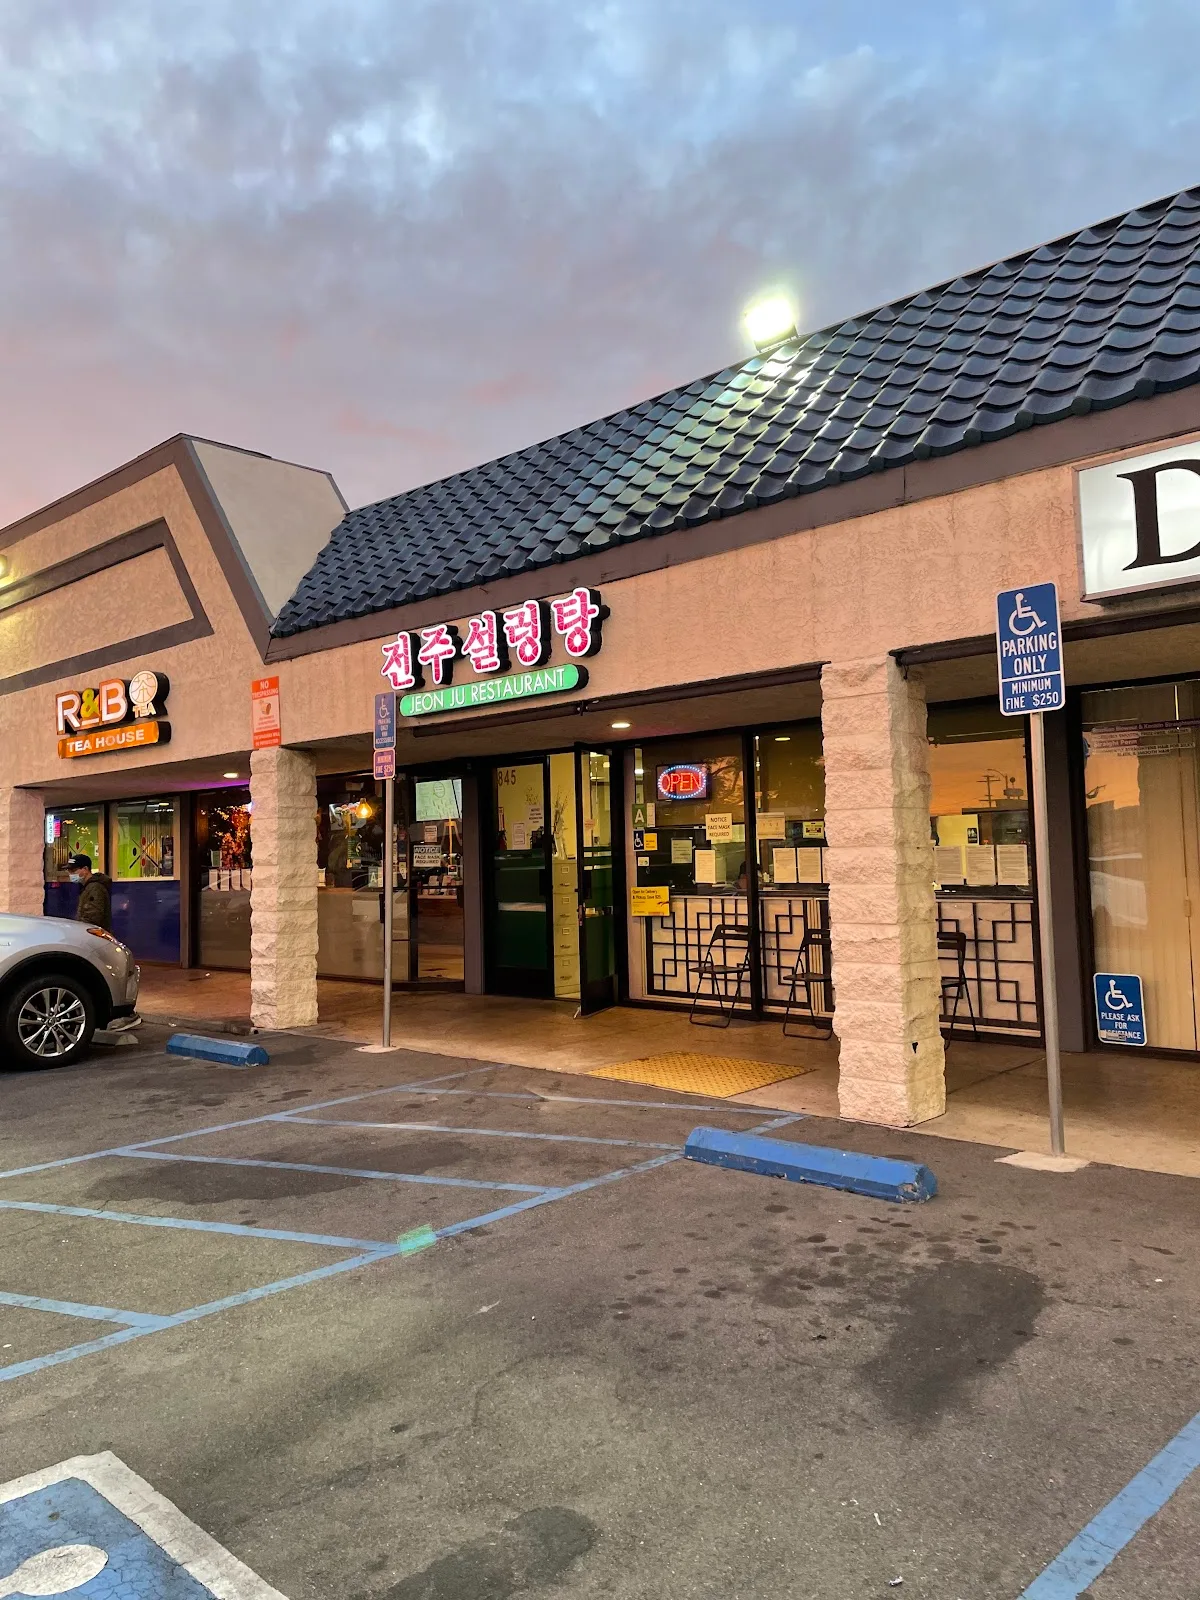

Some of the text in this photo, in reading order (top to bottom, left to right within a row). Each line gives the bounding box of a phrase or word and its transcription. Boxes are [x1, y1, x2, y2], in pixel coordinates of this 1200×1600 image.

[1116, 459, 1200, 571] D
[1002, 632, 1057, 658] PARKING
[1014, 654, 1047, 676] ONLY
[260, 680, 269, 689] NO
[409, 668, 566, 715] JEON JU RESTAURANT
[1011, 678, 1052, 695] MINIMUM
[56, 680, 128, 733] R&B
[1006, 691, 1059, 710] FINE $250
[133, 702, 157, 719] TEA
[67, 729, 145, 753] TEA HOUSE
[661, 772, 702, 792] OPEN
[635, 808, 645, 823] A
[1101, 1012, 1140, 1022] PLEASE ASK
[1114, 1021, 1128, 1029] FOR
